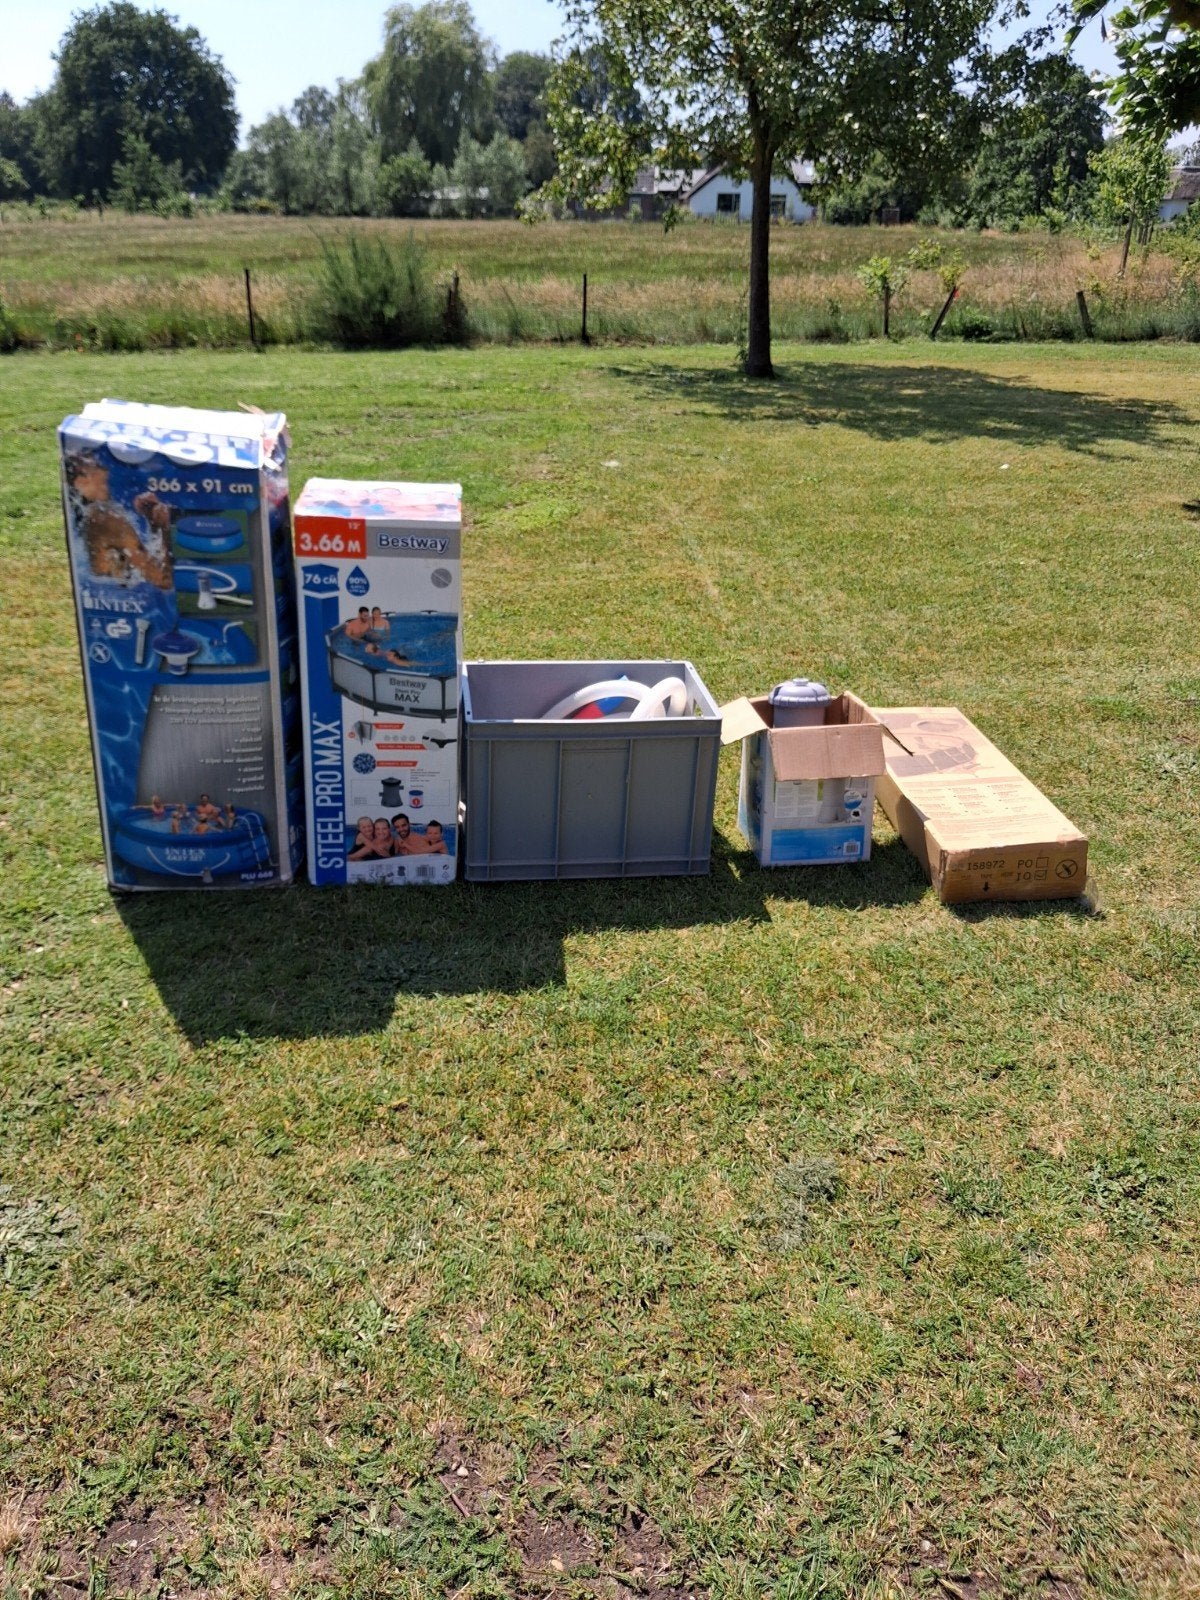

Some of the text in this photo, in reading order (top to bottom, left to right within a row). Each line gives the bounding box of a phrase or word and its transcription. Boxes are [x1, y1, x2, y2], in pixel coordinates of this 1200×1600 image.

[147, 477, 253, 494] 366 x 91 cm
[300, 533, 361, 553] 3.66 M
[377, 533, 449, 553] Bestway
[305, 574, 321, 585] 76
[93, 597, 146, 614] INTEX
[389, 677, 427, 691] Bestway
[394, 693, 420, 703] MAX
[312, 720, 345, 869] STEEL PRO MAX
[1017, 859, 1033, 869] PO
